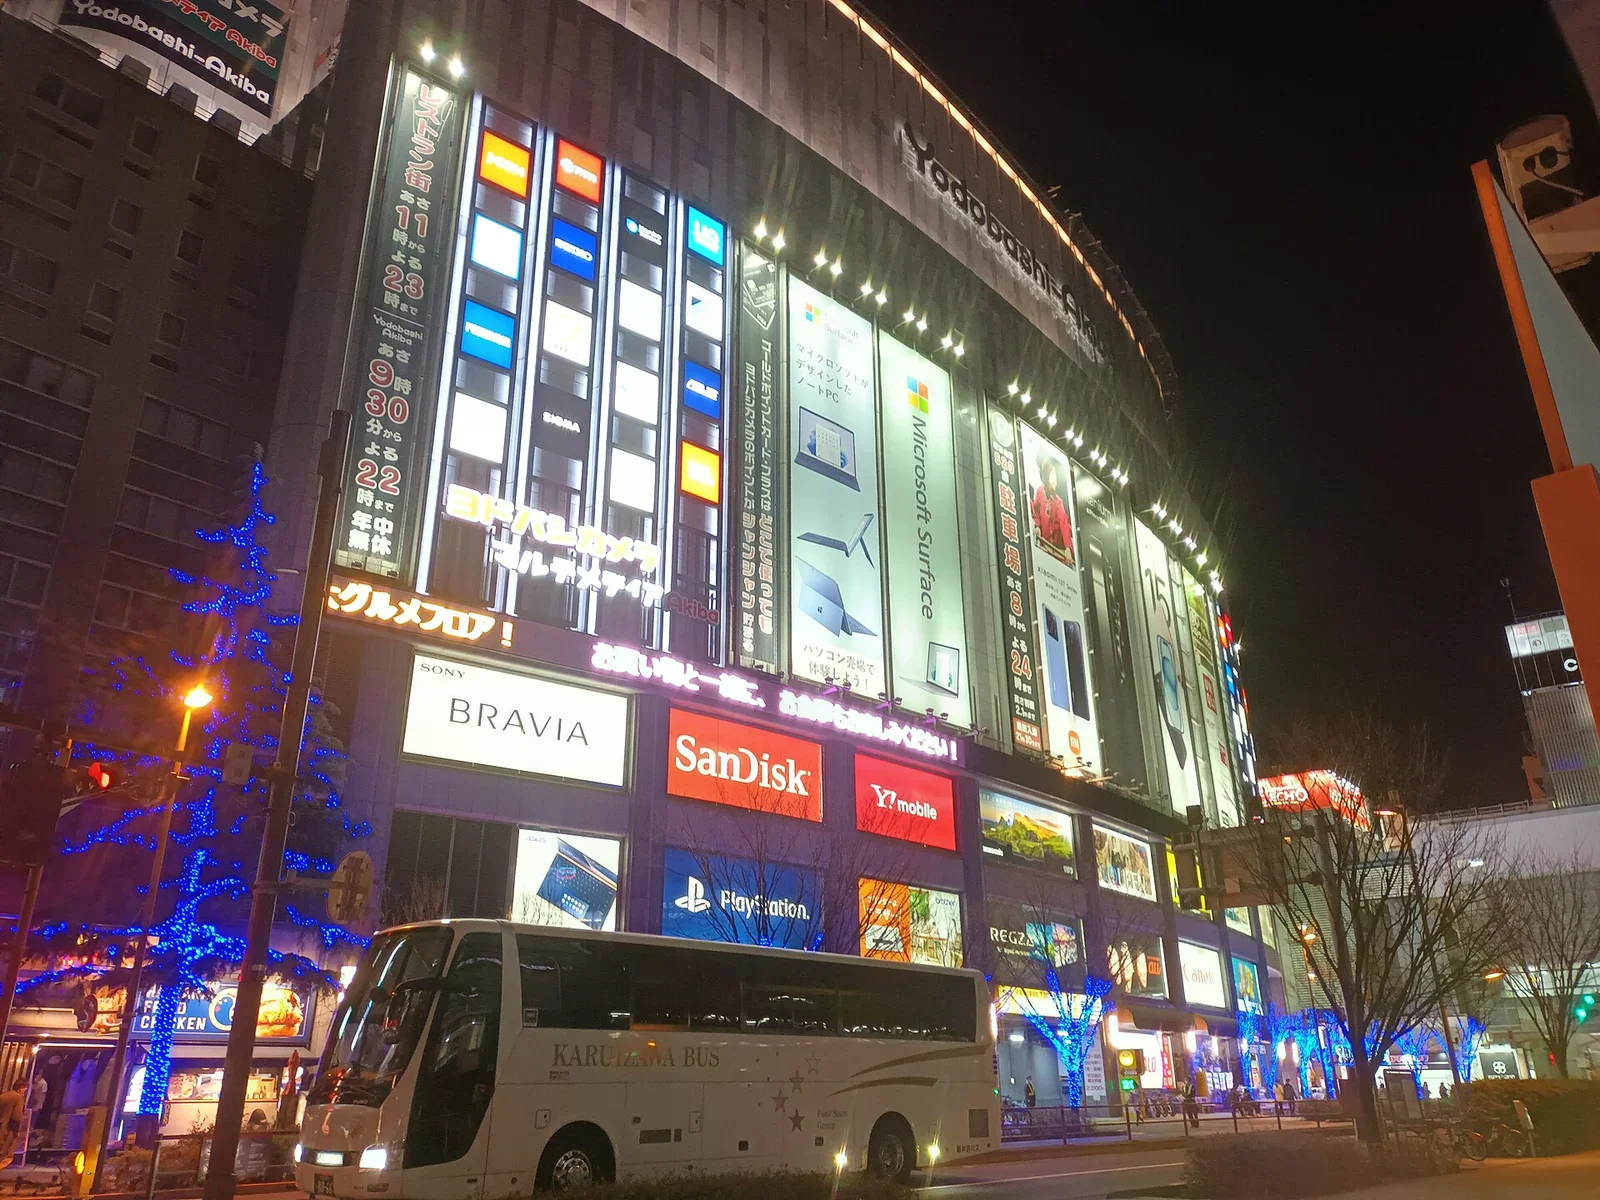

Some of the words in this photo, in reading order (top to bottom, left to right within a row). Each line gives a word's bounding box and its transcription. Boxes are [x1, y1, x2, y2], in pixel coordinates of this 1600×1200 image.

[73, 0, 271, 105] Yodobashi-Akiba
[226, 30, 277, 68] Akiba
[405, 84, 441, 193] レストラン街
[400, 189, 431, 211] あさ
[395, 205, 429, 238] 11
[392, 228, 426, 253] 時から
[391, 251, 423, 271] よる
[383, 264, 424, 300] 23
[384, 291, 419, 316] 時まで
[373, 314, 423, 340] Yodobashi
[382, 328, 412, 345] Akiba
[378, 342, 411, 363] あさ
[797, 343, 868, 388] マイクロソフトが
[797, 359, 852, 396] デザインした
[798, 377, 839, 403] ノートPC
[365, 388, 409, 424] 30
[366, 417, 402, 442] 分から
[365, 441, 398, 461] よる
[355, 458, 401, 496] 22
[912, 415, 932, 525] Microsoft
[356, 488, 394, 513] 時まで
[351, 510, 394, 536] 年中
[446, 484, 661, 573] ヨドバシカメラ
[998, 481, 1022, 576] 駐車場
[348, 528, 392, 556] 無休
[917, 528, 936, 620] Surface
[666, 591, 719, 625] Akiba
[1010, 590, 1023, 617] 8
[1012, 636, 1028, 653] よる
[420, 662, 466, 679] SONY
[1011, 649, 1032, 681] 24
[449, 697, 589, 746] BRAVIA
[675, 734, 810, 796] SanDisk
[720, 889, 811, 920] PlayStation
[990, 927, 1035, 947] REGZA
[1148, 962, 1162, 976] au
[1182, 962, 1215, 986] Canon
[140, 1014, 206, 1031] CKEN
[552, 1043, 675, 1067] KARUIZAWA
[682, 1046, 720, 1068] BUS
[816, 1121, 837, 1132] Group
